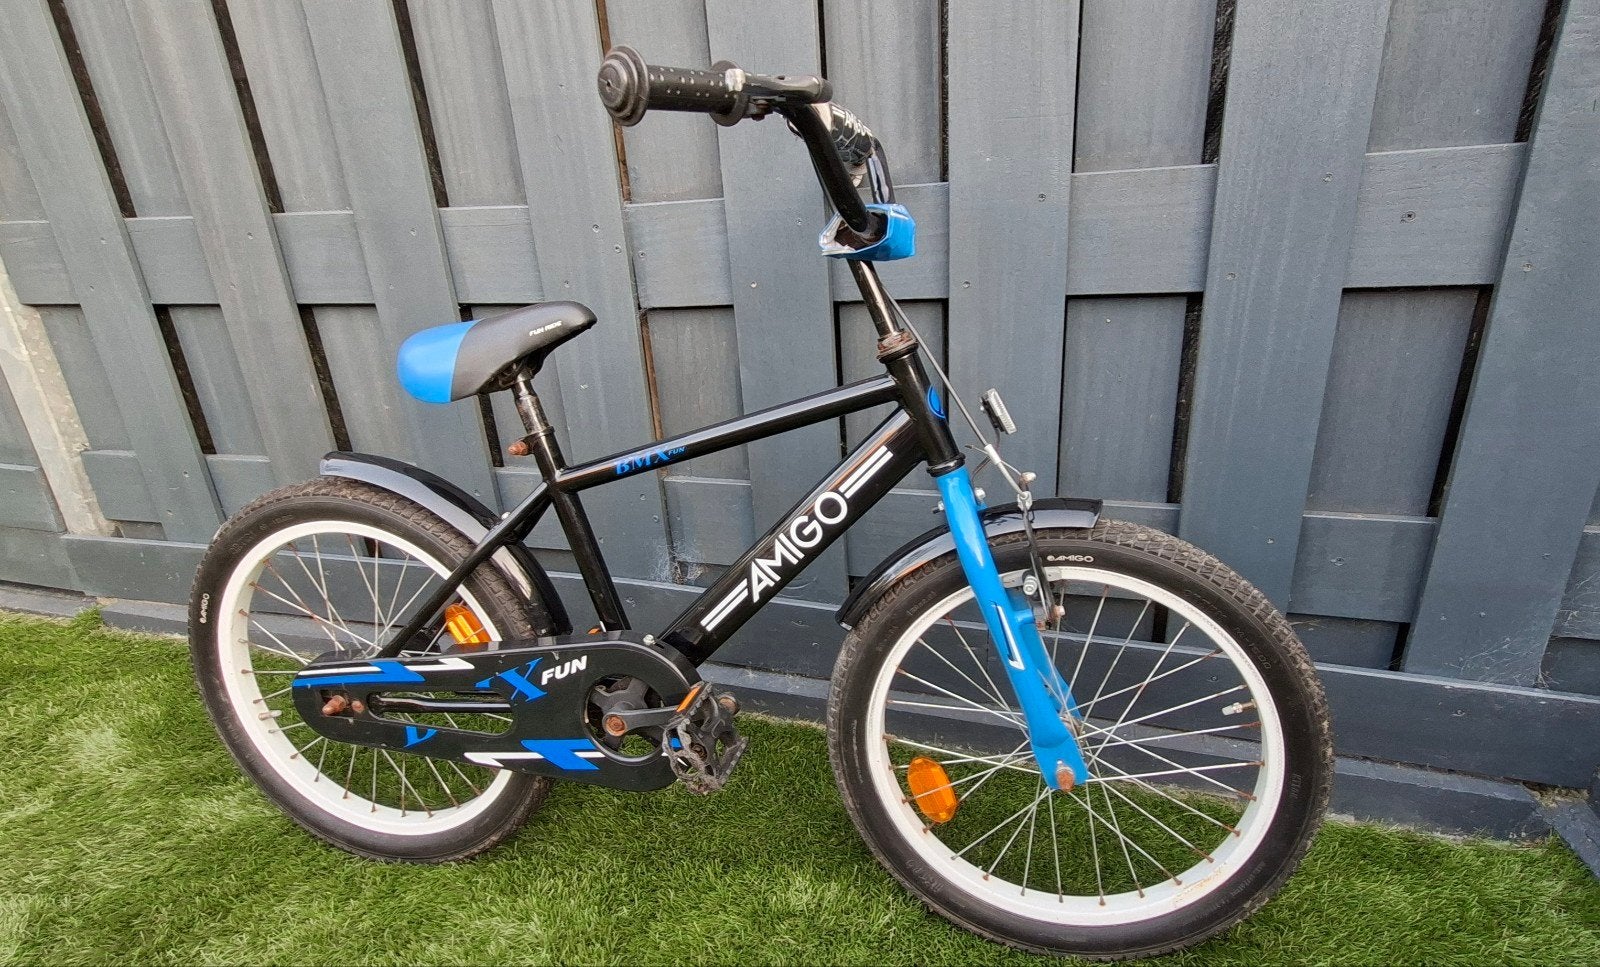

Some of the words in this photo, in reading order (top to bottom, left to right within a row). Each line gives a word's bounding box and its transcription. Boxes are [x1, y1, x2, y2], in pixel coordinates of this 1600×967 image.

[615, 446, 670, 475] BMX
[668, 446, 685, 456] FUN
[751, 491, 848, 604] AMIGO
[1054, 554, 1095, 563] AMIGO
[200, 593, 210, 619] AMIGO
[540, 655, 588, 686] FUN
